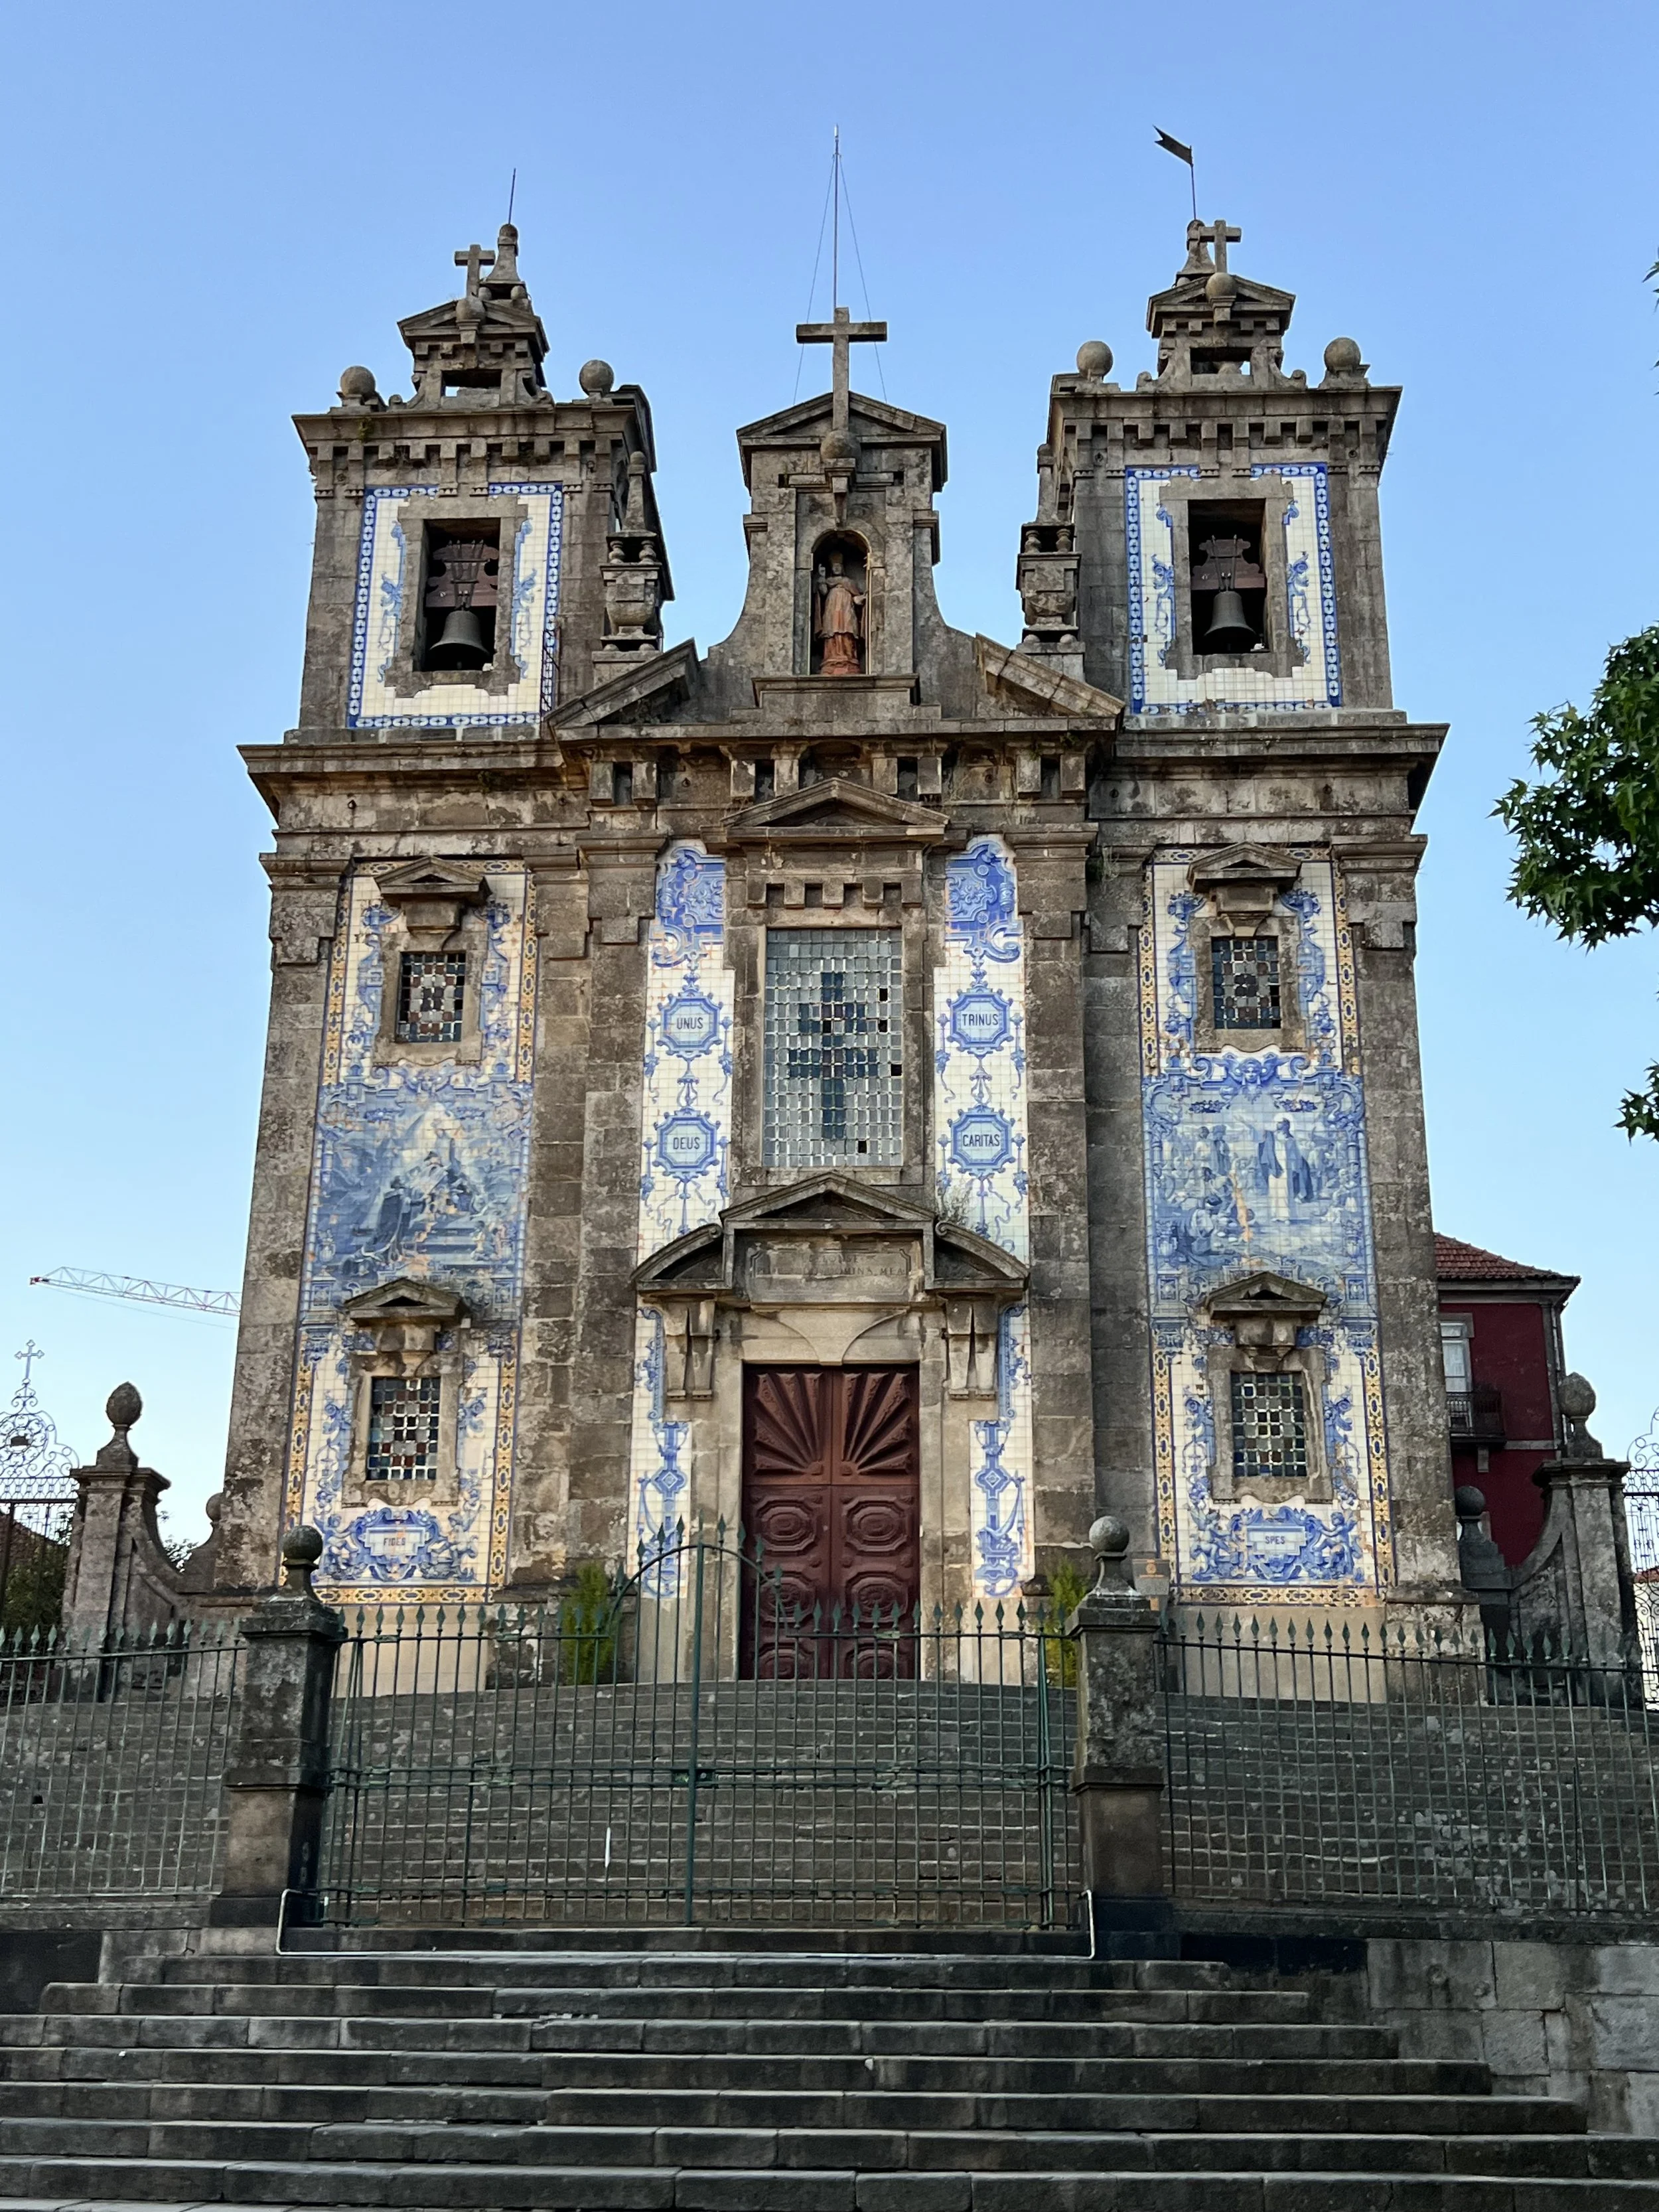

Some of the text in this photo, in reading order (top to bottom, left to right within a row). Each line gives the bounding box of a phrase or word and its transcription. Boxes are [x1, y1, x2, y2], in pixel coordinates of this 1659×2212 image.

[676, 1017, 703, 1030] UNUS
[962, 1013, 999, 1026] TRINUS
[672, 1137, 701, 1149] DEUS
[962, 1134, 1000, 1147] CARITAS
[383, 1537, 405, 1546] FIDES
[1264, 1536, 1285, 1545] SPES
